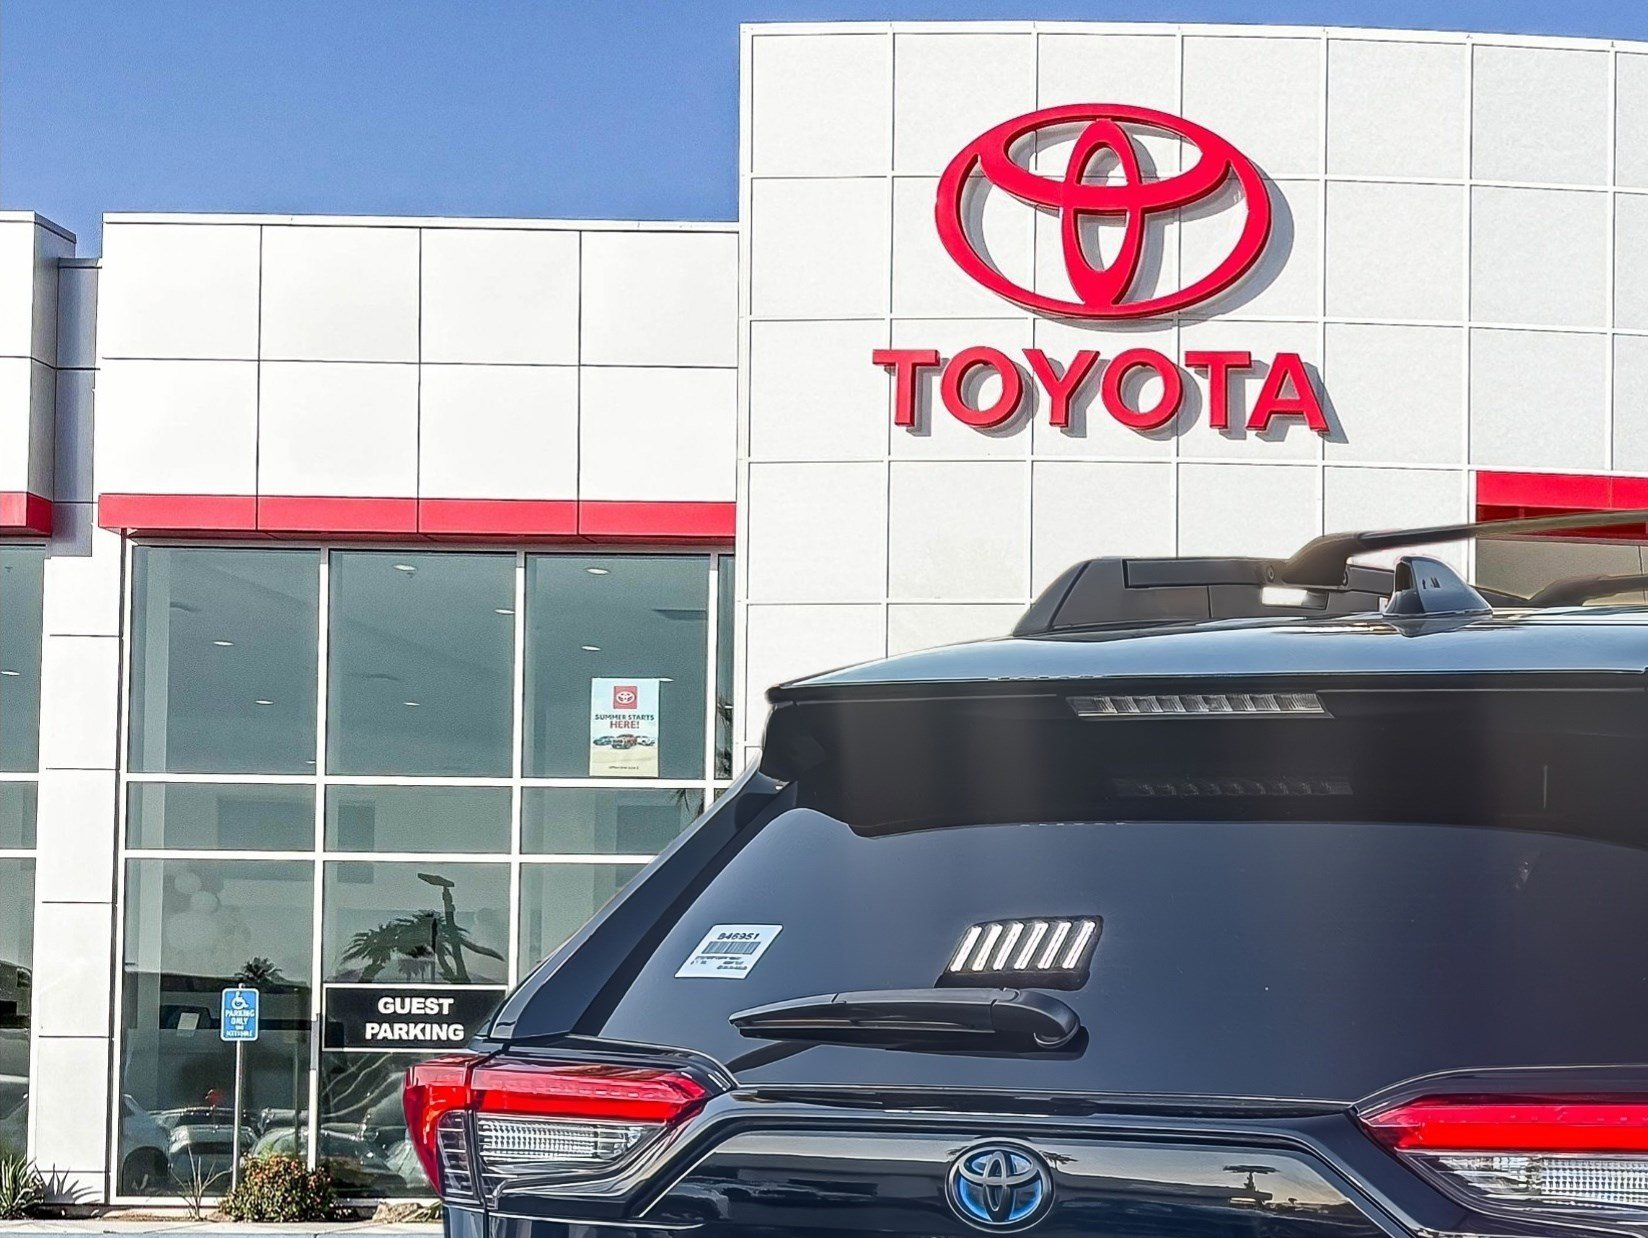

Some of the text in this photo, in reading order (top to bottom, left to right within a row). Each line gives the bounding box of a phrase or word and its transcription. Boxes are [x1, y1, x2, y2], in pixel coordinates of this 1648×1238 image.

[873, 346, 1329, 432] TOYOTA
[610, 720, 640, 729] HERE!
[377, 997, 455, 1015] GUEST
[225, 1009, 255, 1017] PARKING
[230, 1017, 249, 1025] ONLY
[365, 1022, 465, 1041] PARKING
